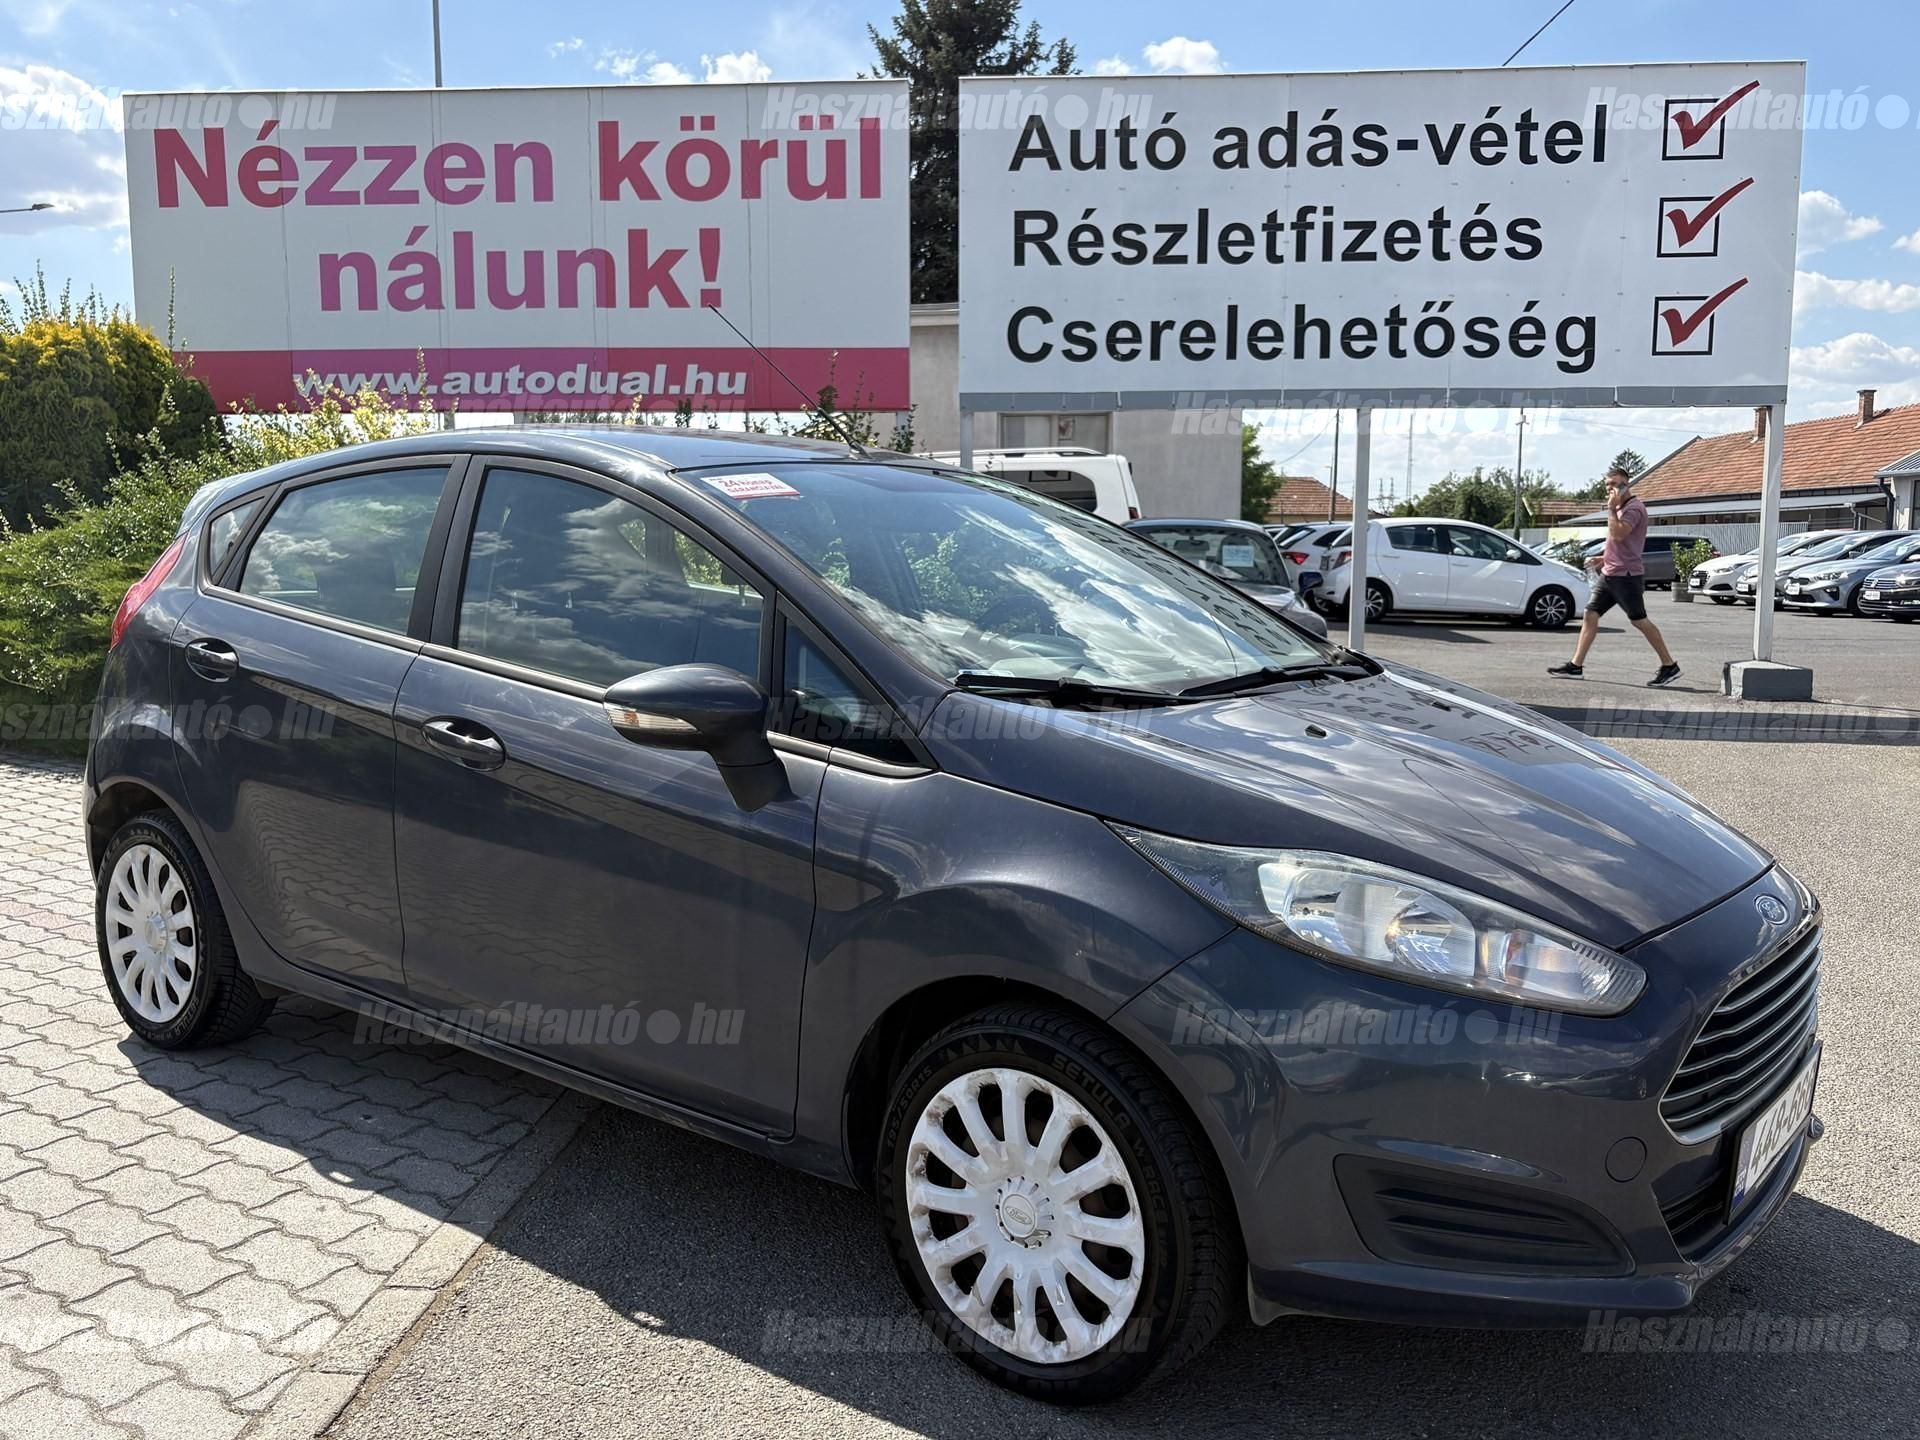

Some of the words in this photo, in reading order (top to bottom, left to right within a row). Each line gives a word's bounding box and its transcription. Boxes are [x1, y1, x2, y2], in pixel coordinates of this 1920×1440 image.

[155, 120, 554, 208] Nézzen
[599, 115, 881, 201] körül
[1009, 111, 1186, 172] Autó
[1212, 105, 1607, 170] adás-vétel
[319, 226, 721, 311] nálunk!
[1013, 202, 1543, 267] Részletfizetés
[1007, 300, 1597, 374] Cserelehetőség
[293, 363, 748, 396] www.autodual.hu
[1050, 1053, 1131, 1129] SETULA
